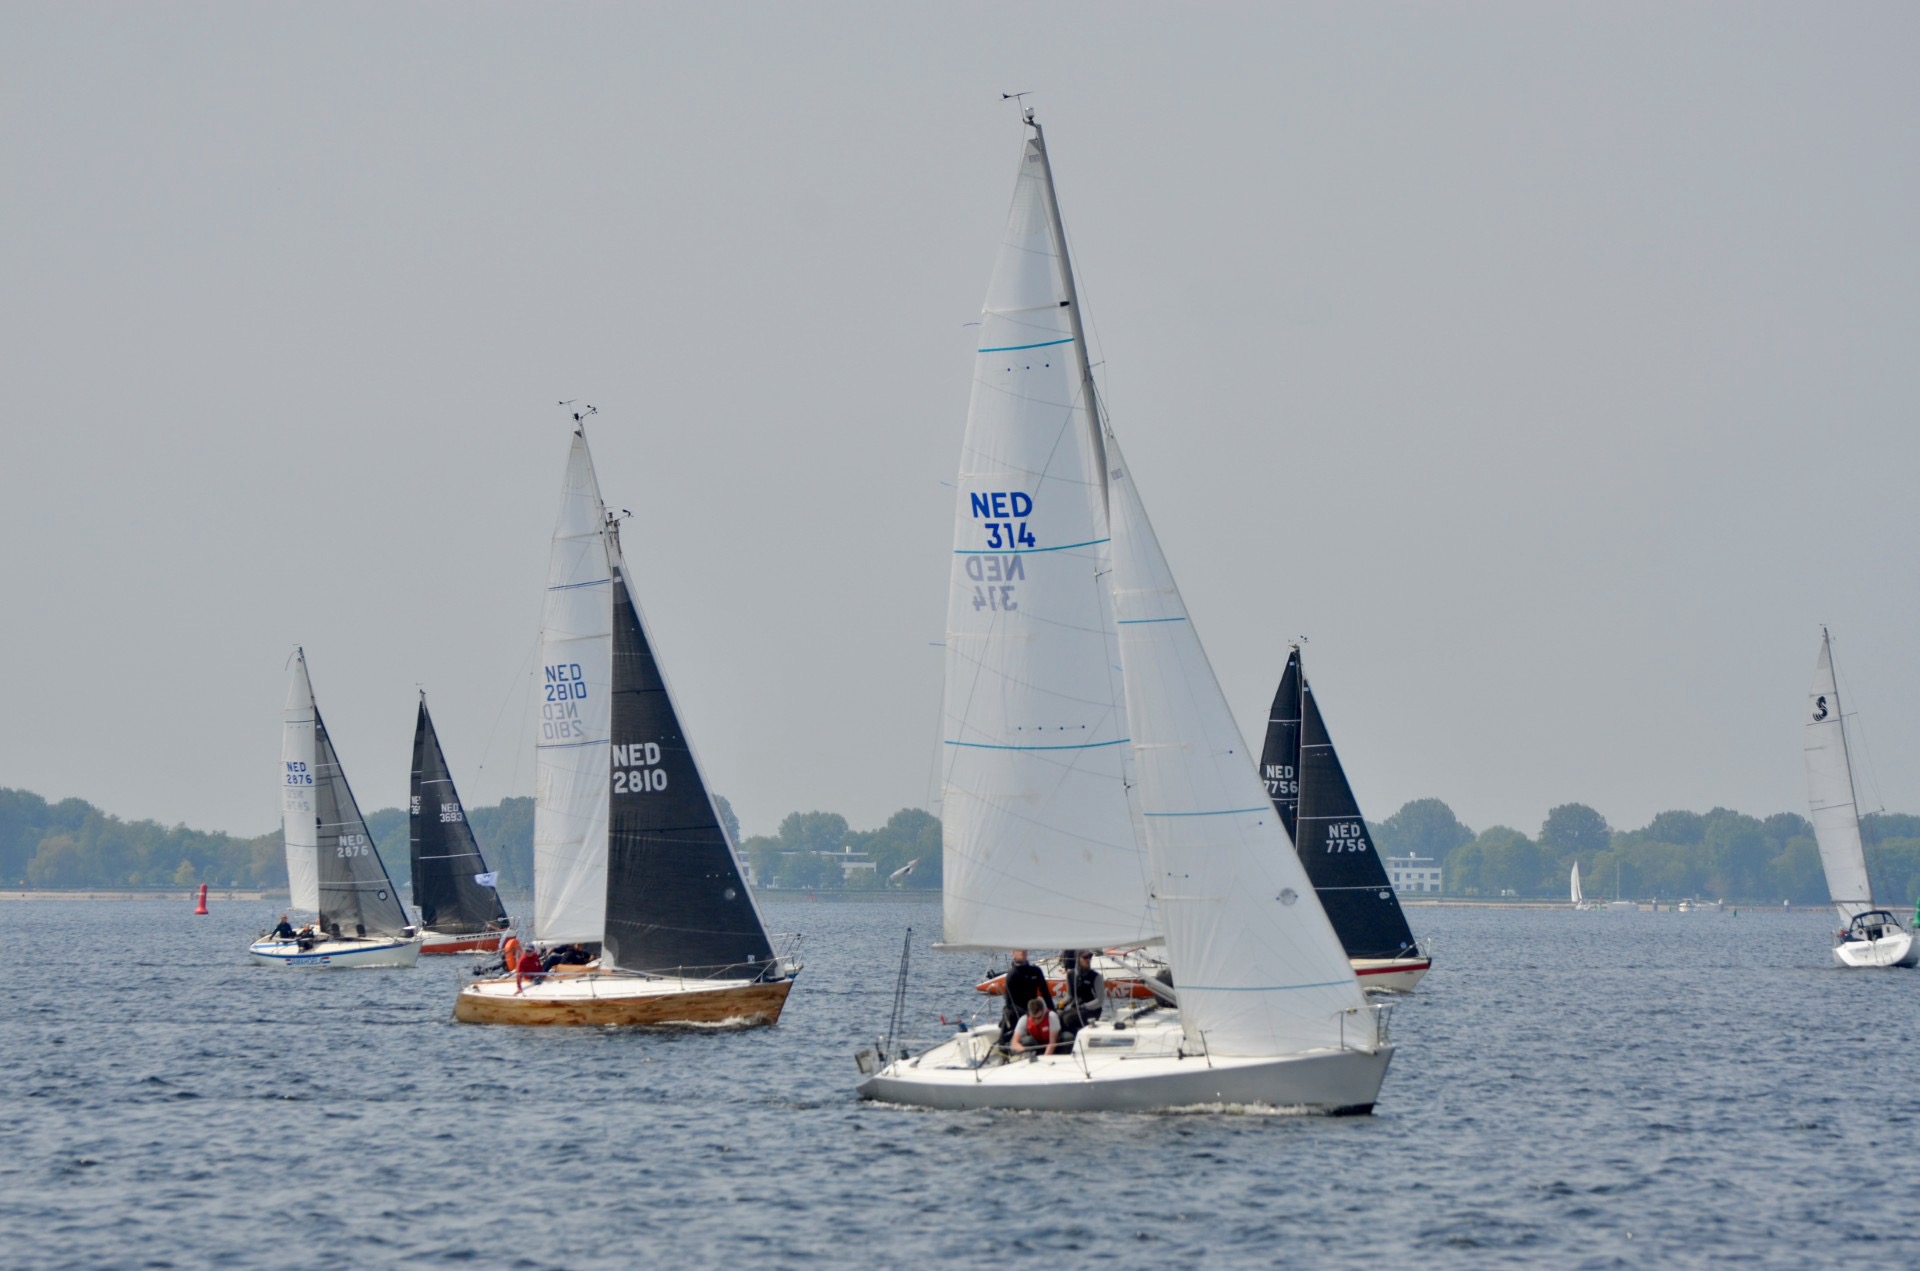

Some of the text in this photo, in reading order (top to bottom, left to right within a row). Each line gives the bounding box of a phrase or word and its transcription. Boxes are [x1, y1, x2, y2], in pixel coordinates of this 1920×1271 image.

[970, 492, 1033, 518] NED
[985, 522, 1036, 549] 314
[545, 664, 582, 682] NED
[544, 681, 587, 701] 2810
[612, 742, 661, 767] NED
[286, 761, 307, 772] NED
[1266, 764, 1294, 779] NED
[286, 774, 313, 785] 2876
[613, 768, 668, 794] 2810
[1263, 780, 1299, 794] 7756
[441, 802, 460, 813] NED
[439, 812, 463, 823] 3693
[1328, 824, 1361, 839] NED
[339, 834, 365, 847] NED
[1325, 838, 1367, 853] 7756
[336, 845, 369, 858] 2876
